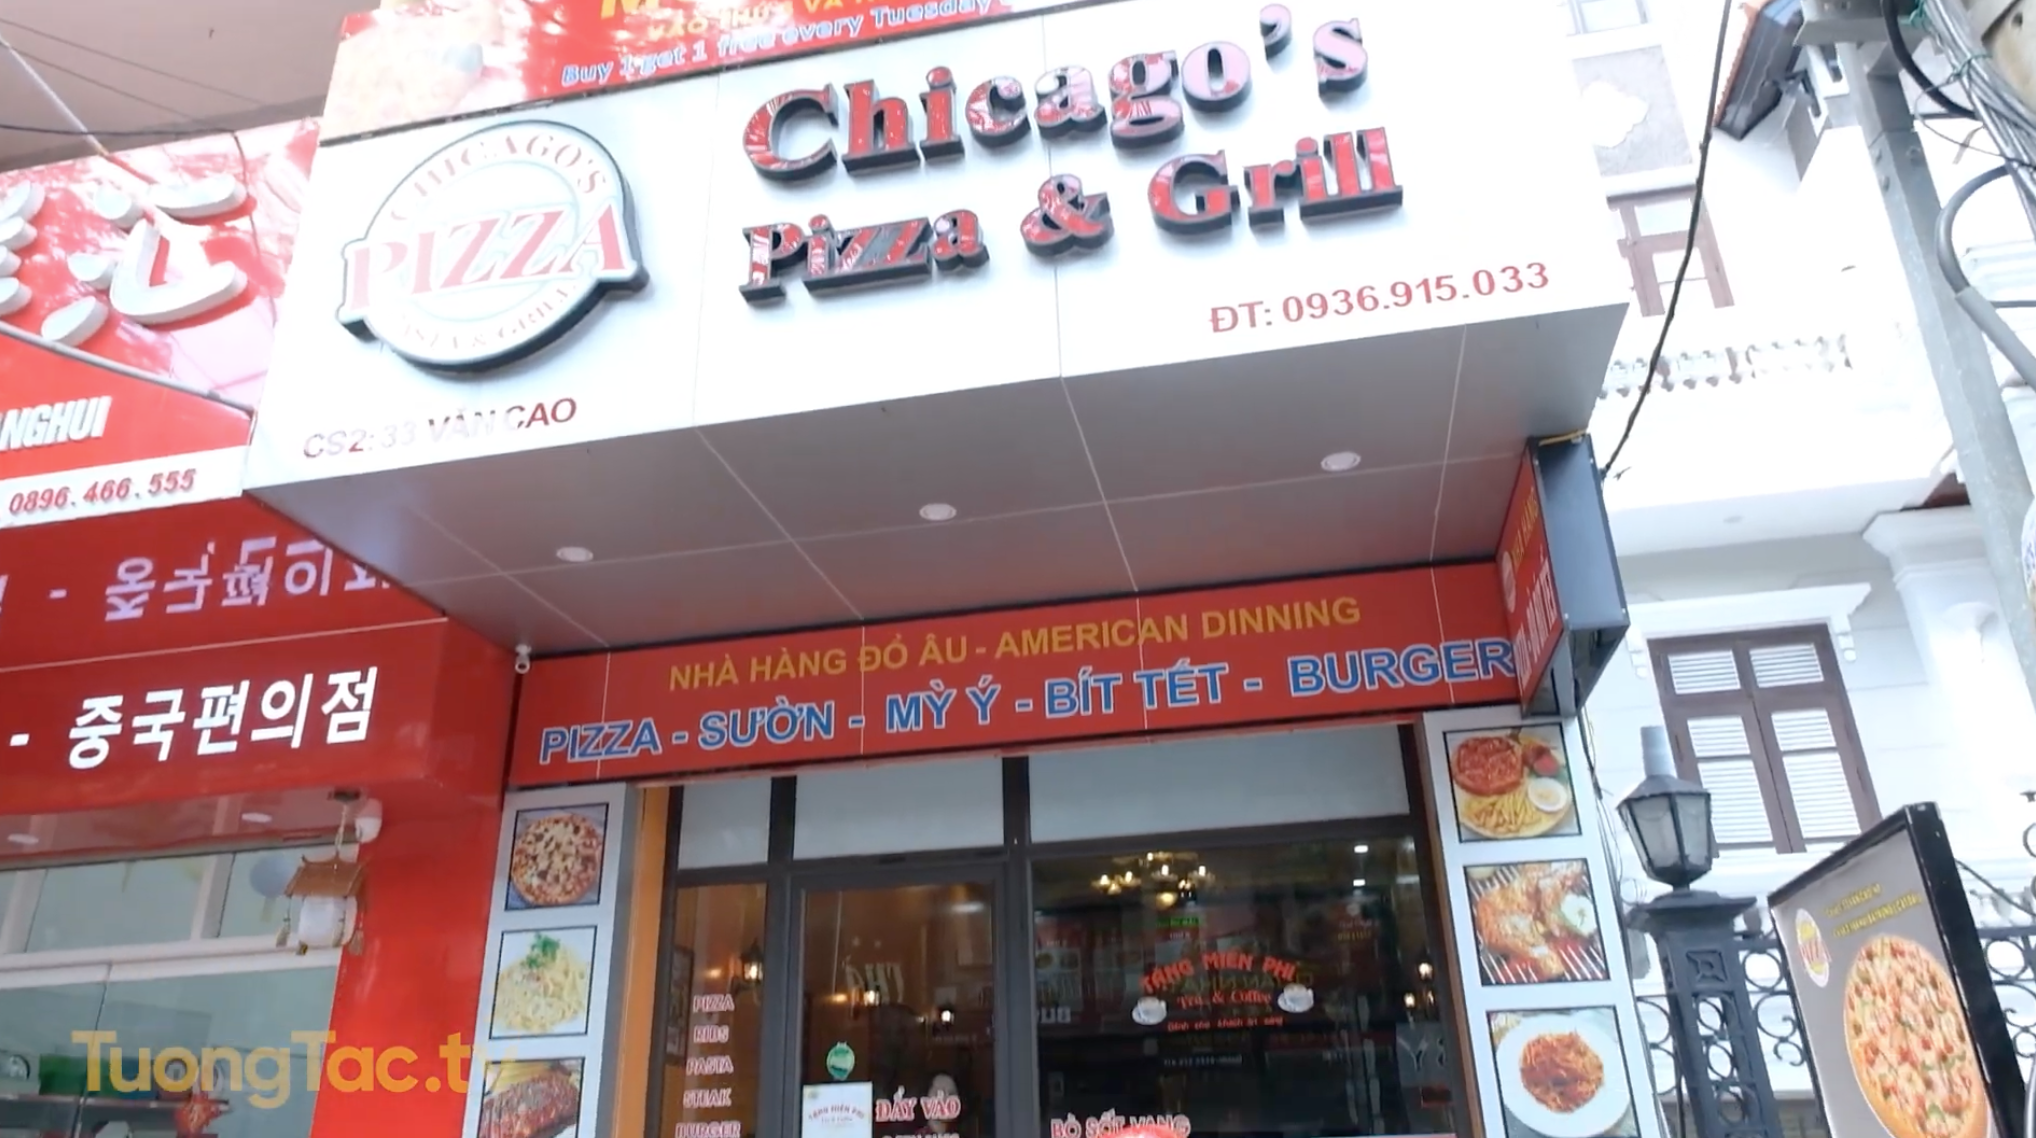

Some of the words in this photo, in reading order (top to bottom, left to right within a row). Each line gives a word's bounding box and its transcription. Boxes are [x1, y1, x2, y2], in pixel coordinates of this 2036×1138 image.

[561, 61, 613, 86] Buy
[638, 46, 686, 75] get
[692, 39, 707, 62] 1
[718, 29, 776, 57] free
[781, 15, 864, 45] every
[870, 0, 992, 28] Tuesday
[742, 4, 1369, 182] Chicago's
[739, 208, 990, 304] Pizza
[1020, 174, 1114, 257] &
[1147, 127, 1402, 233] Grill
[350, 203, 626, 310] PIZZA
[1208, 301, 1273, 333] ĐT:
[1282, 262, 1550, 322] 0936.915.033
[0, 395, 113, 450] NGHUI
[504, 397, 577, 430] CAO
[669, 653, 739, 691] NHÀ
[750, 647, 846, 682] HÀNG
[919, 633, 967, 666] ÂU
[995, 613, 1188, 658] AMERICAN
[1202, 597, 1361, 639] DINNING
[68, 667, 378, 769] 중국편의점
[539, 717, 662, 764] PIZZA
[698, 696, 834, 750] SƯỜN
[885, 678, 957, 733] MỲ
[965, 674, 1001, 725] Ý
[1044, 665, 1123, 718] BÍT
[1133, 657, 1229, 709] TẾT
[1287, 637, 1516, 697] BURGER
[693, 993, 735, 1013] PIZZA
[682, 1087, 732, 1109] STEAK
[686, 1055, 734, 1076] PASTA
[675, 1120, 741, 1138] BURGER
[1050, 1112, 1082, 1138] BÒ
